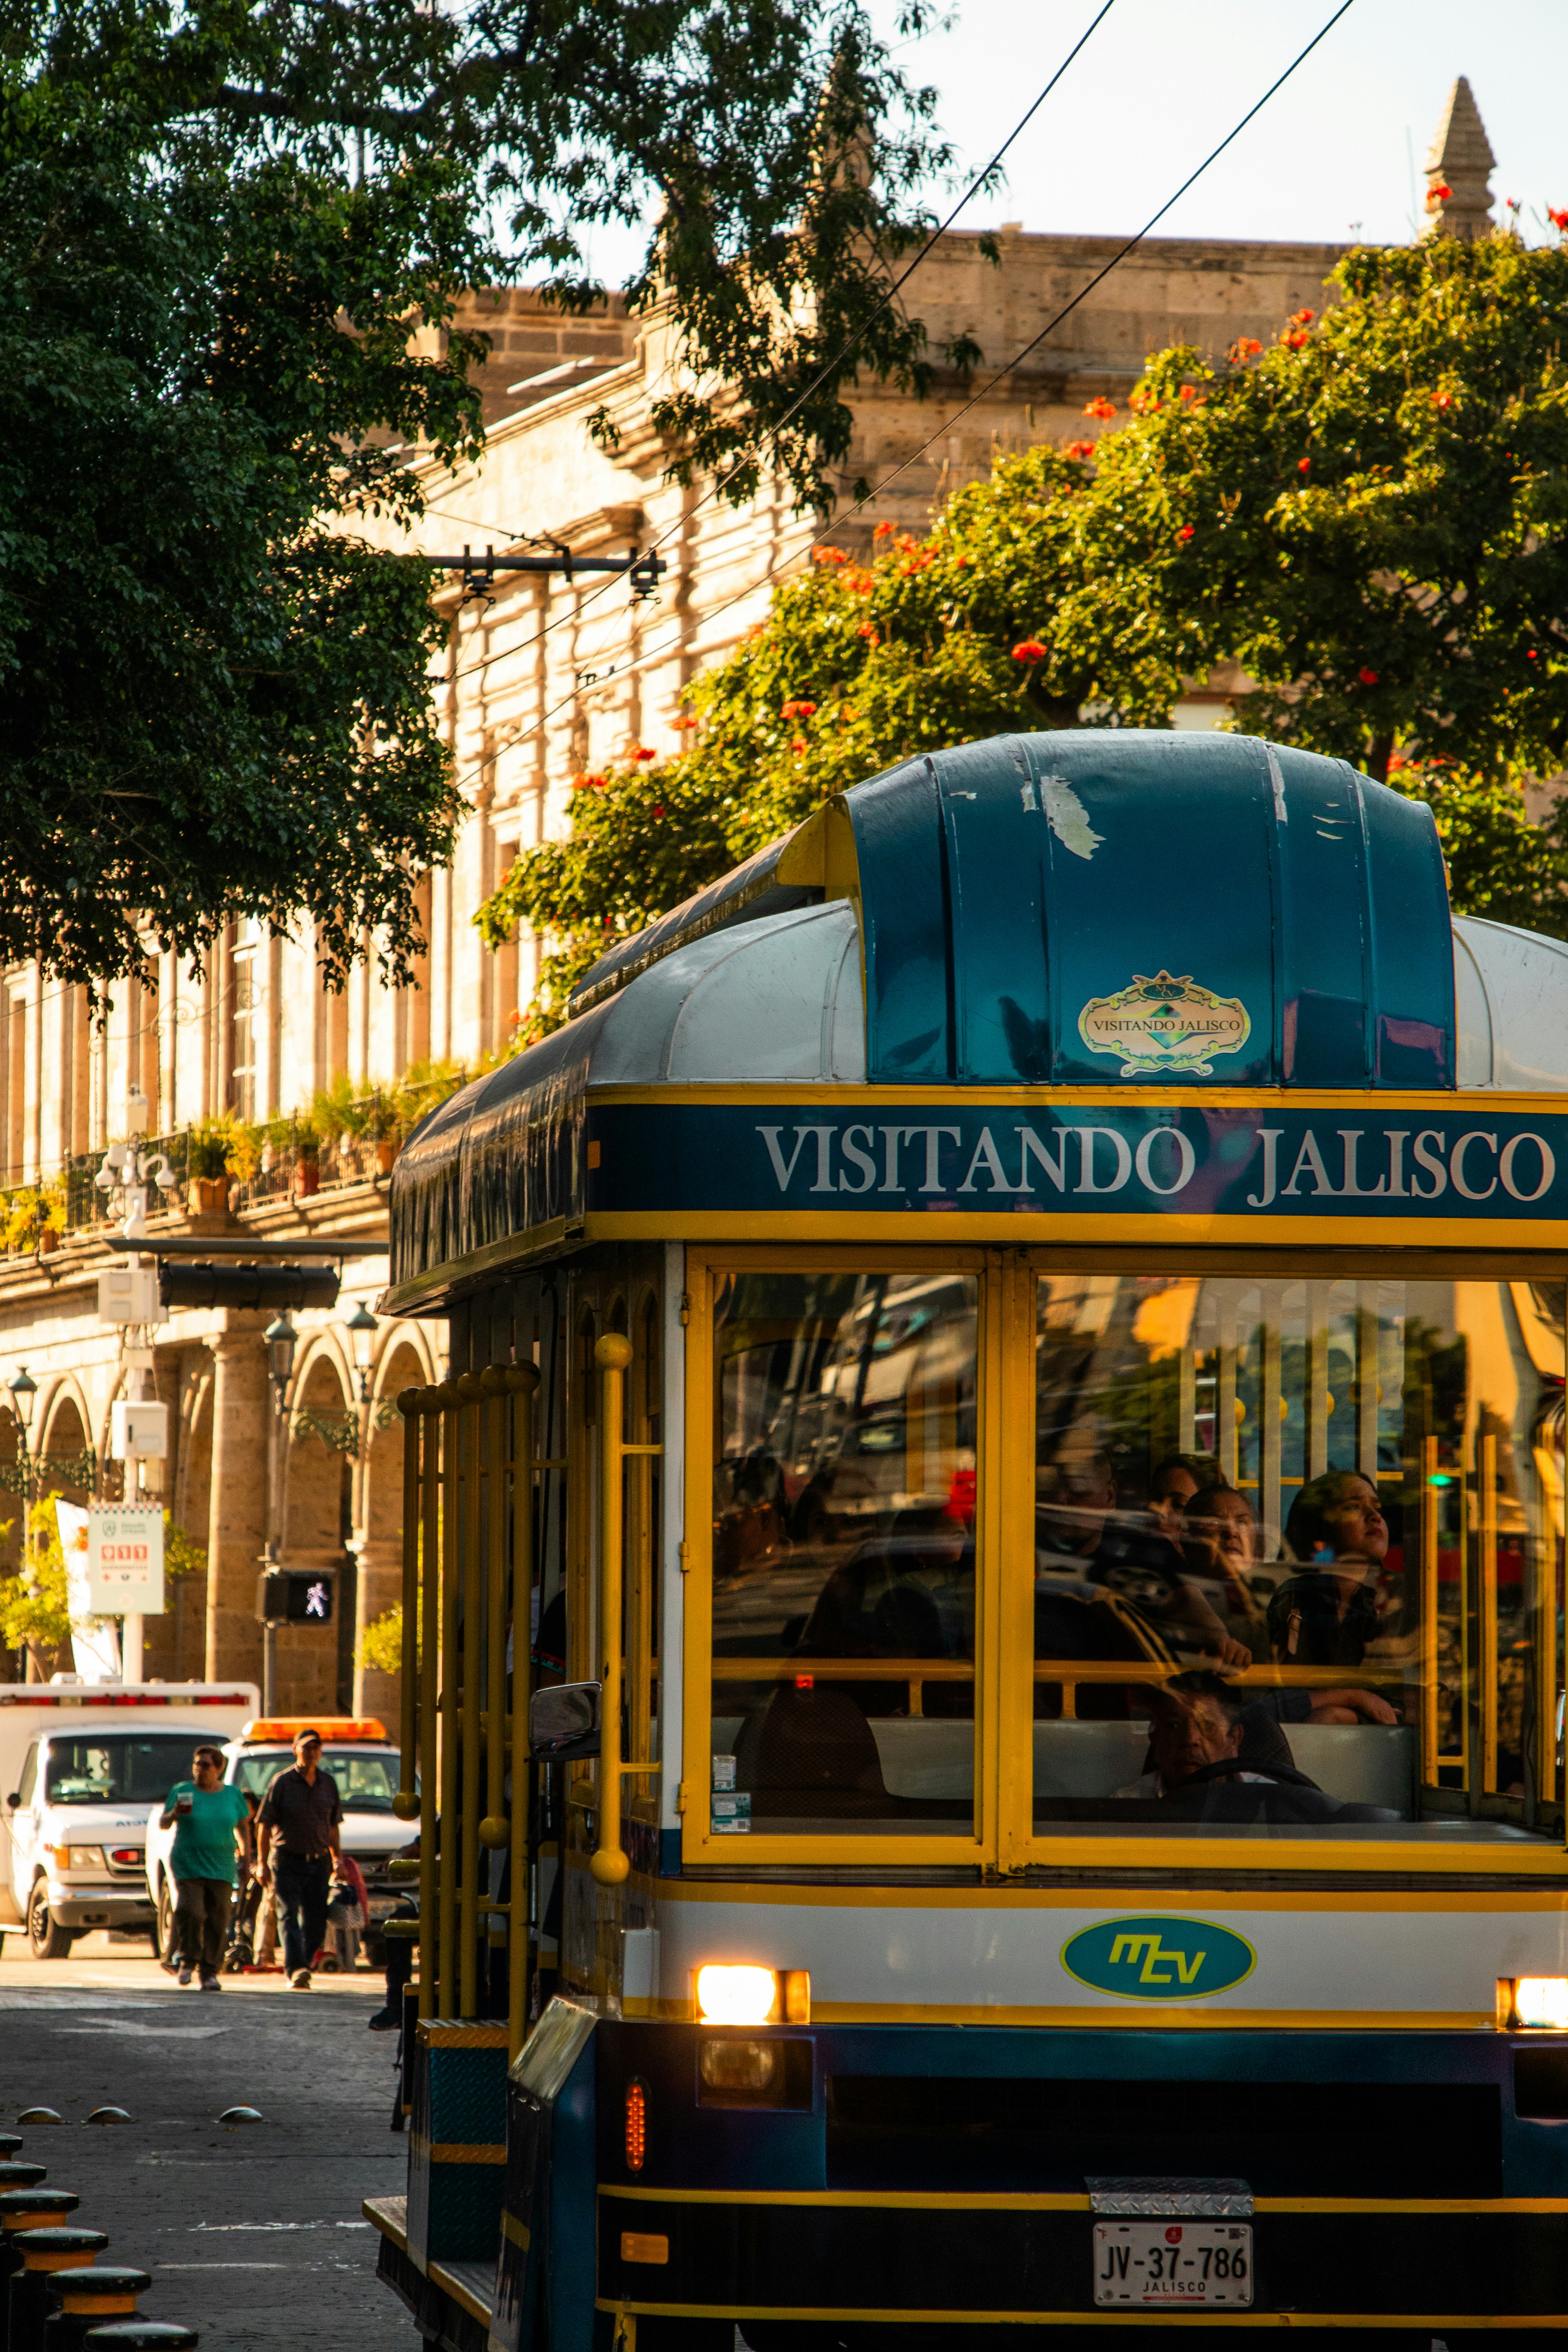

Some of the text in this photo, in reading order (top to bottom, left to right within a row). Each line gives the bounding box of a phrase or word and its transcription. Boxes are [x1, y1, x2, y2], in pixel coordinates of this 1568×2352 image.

[1093, 1020, 1240, 1031] VISITANDO JALISCO
[755, 1125, 1556, 1207] VISITANDO JALISCO
[1100, 2246, 1246, 2280] JV-37-786
[1143, 2282, 1205, 2292] JALISCO
